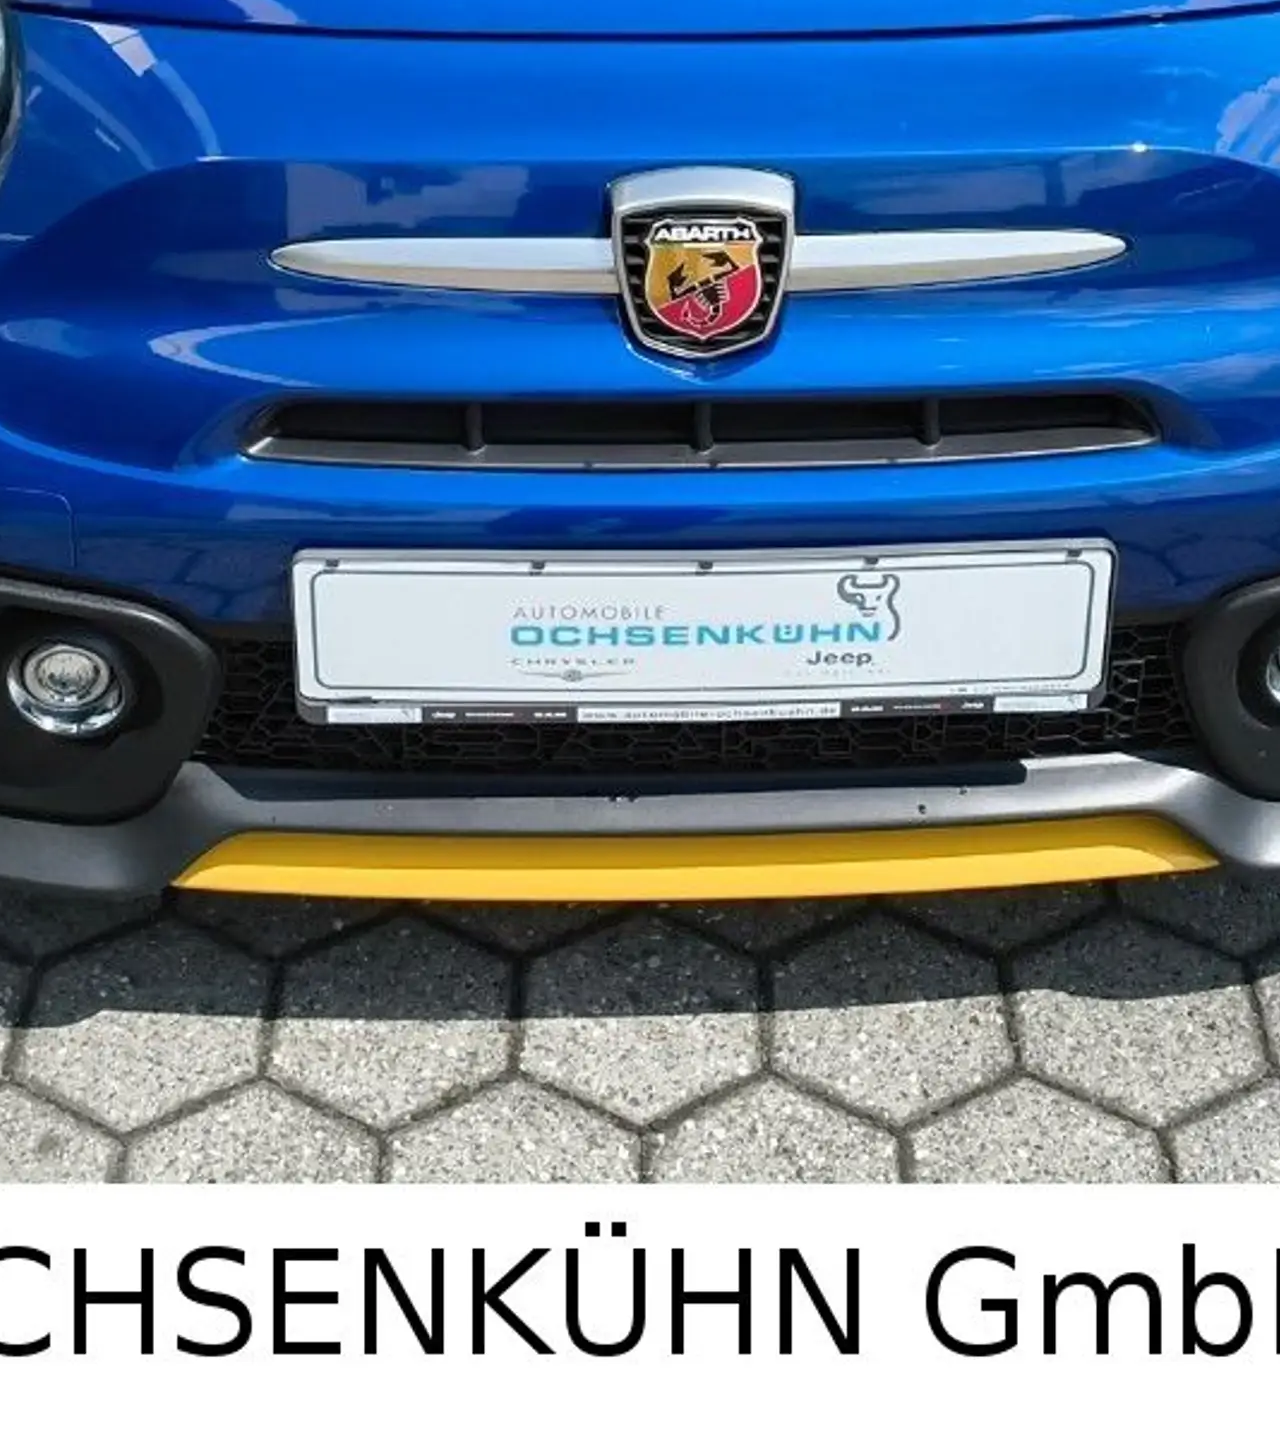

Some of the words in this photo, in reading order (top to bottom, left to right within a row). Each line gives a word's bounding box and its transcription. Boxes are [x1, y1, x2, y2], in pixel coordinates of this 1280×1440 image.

[654, 224, 750, 241] ABARTH
[512, 604, 667, 621] AUTOMOBILE
[511, 622, 881, 647] OCHSENKÜHN
[806, 650, 873, 667] Jeep
